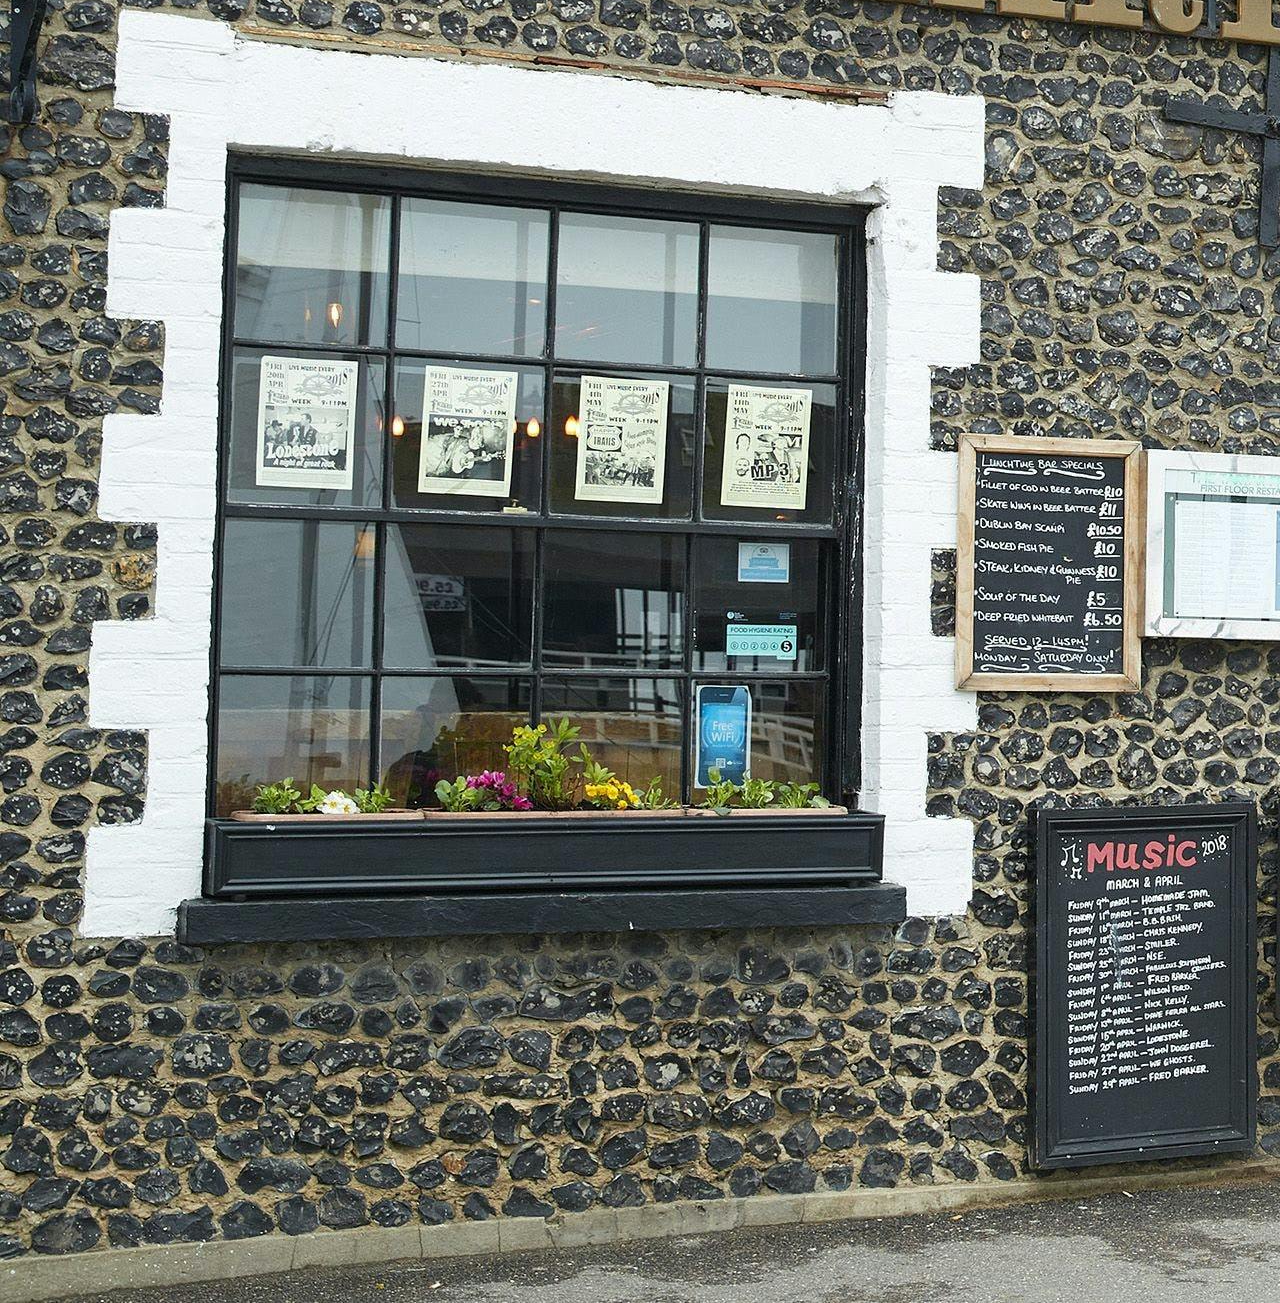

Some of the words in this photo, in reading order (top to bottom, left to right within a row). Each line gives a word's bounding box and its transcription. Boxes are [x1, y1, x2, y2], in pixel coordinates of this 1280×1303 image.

[1038, 459, 1058, 469] BAR
[1060, 460, 1104, 471] SPECIALS
[1021, 484, 1039, 493] COD
[1050, 485, 1071, 494] BEER
[1104, 485, 1123, 498] £10
[1200, 484, 1222, 493] FIRST
[1225, 485, 1255, 495] FLOOR
[979, 497, 1008, 509] SKATE
[1098, 502, 1117, 517] £11
[980, 517, 1013, 529] DUBLIN
[1014, 520, 1033, 531] BAY
[978, 538, 1017, 551] SMOKED
[1017, 542, 1038, 553] FISH
[1039, 543, 1054, 554] PIE
[1093, 540, 1116, 555] £10
[1096, 564, 1118, 578] £10
[1065, 575, 1081, 585] PIE
[977, 586, 1003, 602] SOUP
[1005, 593, 1018, 601] OF
[1019, 593, 1038, 603] THE
[1040, 593, 1060, 604] DAY
[977, 611, 1001, 622] DEEP
[1003, 613, 1030, 623] FRIED
[1083, 611, 1123, 627] £6.50
[748, 627, 774, 635] HYGIENE
[984, 634, 1027, 645] SERVED
[974, 651, 1018, 663] MONDAY
[1033, 650, 1083, 664] SATURDAY
[1085, 649, 1114, 664] ONLY!
[712, 720, 734, 731] Free
[1201, 834, 1228, 857] 2018
[1106, 877, 1139, 891] MARCH
[1143, 876, 1151, 888] &
[1155, 874, 1184, 887] APRIL
[1148, 1070, 1171, 1083] FRED
